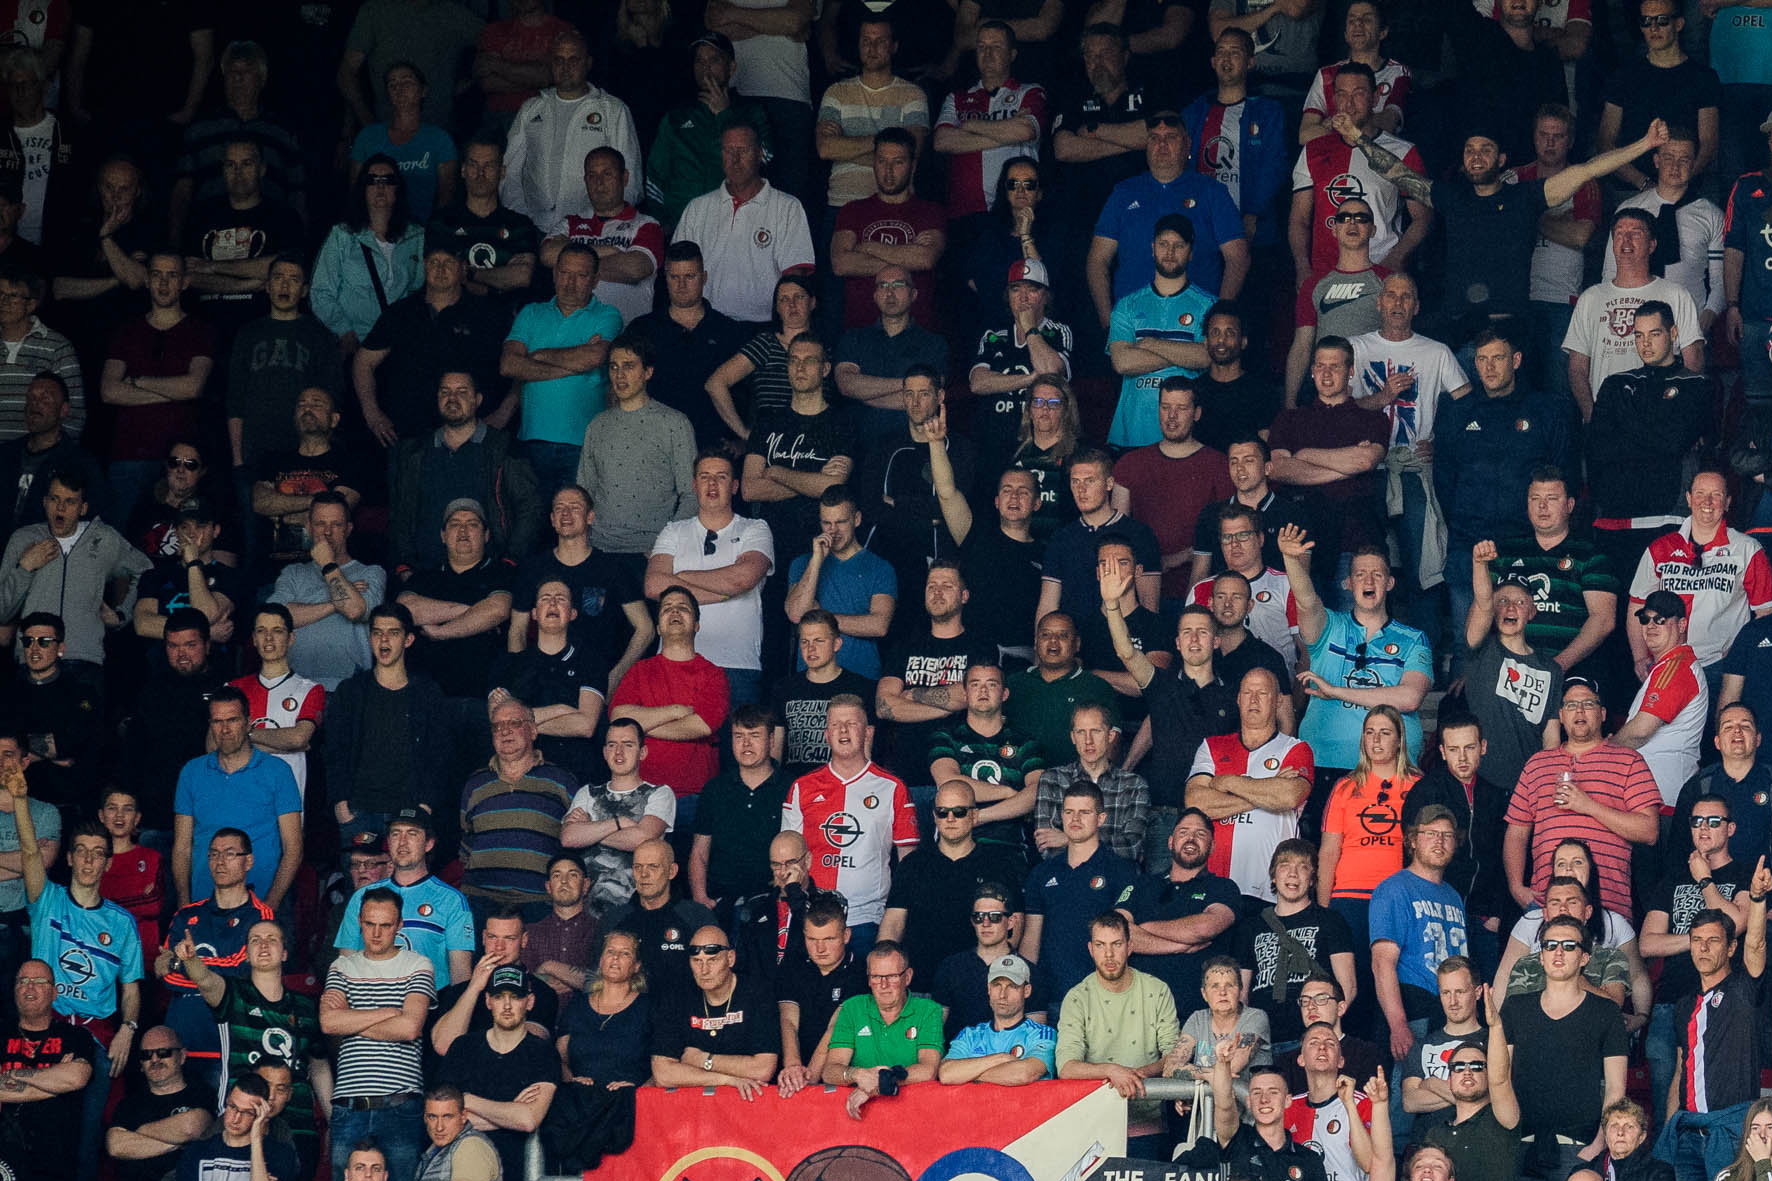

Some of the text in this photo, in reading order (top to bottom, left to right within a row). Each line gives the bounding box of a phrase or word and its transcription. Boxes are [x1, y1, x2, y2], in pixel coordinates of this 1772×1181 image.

[1325, 283, 1365, 300] NIKE
[1135, 377, 1162, 390] OPE
[1683, 562, 1738, 577] ROTTERDAM
[907, 655, 968, 672] FEYENOORD
[1523, 674, 1545, 694] DE
[1220, 813, 1253, 826] OPEL
[1360, 835, 1395, 847] OPEL
[822, 854, 857, 869] OPEL
